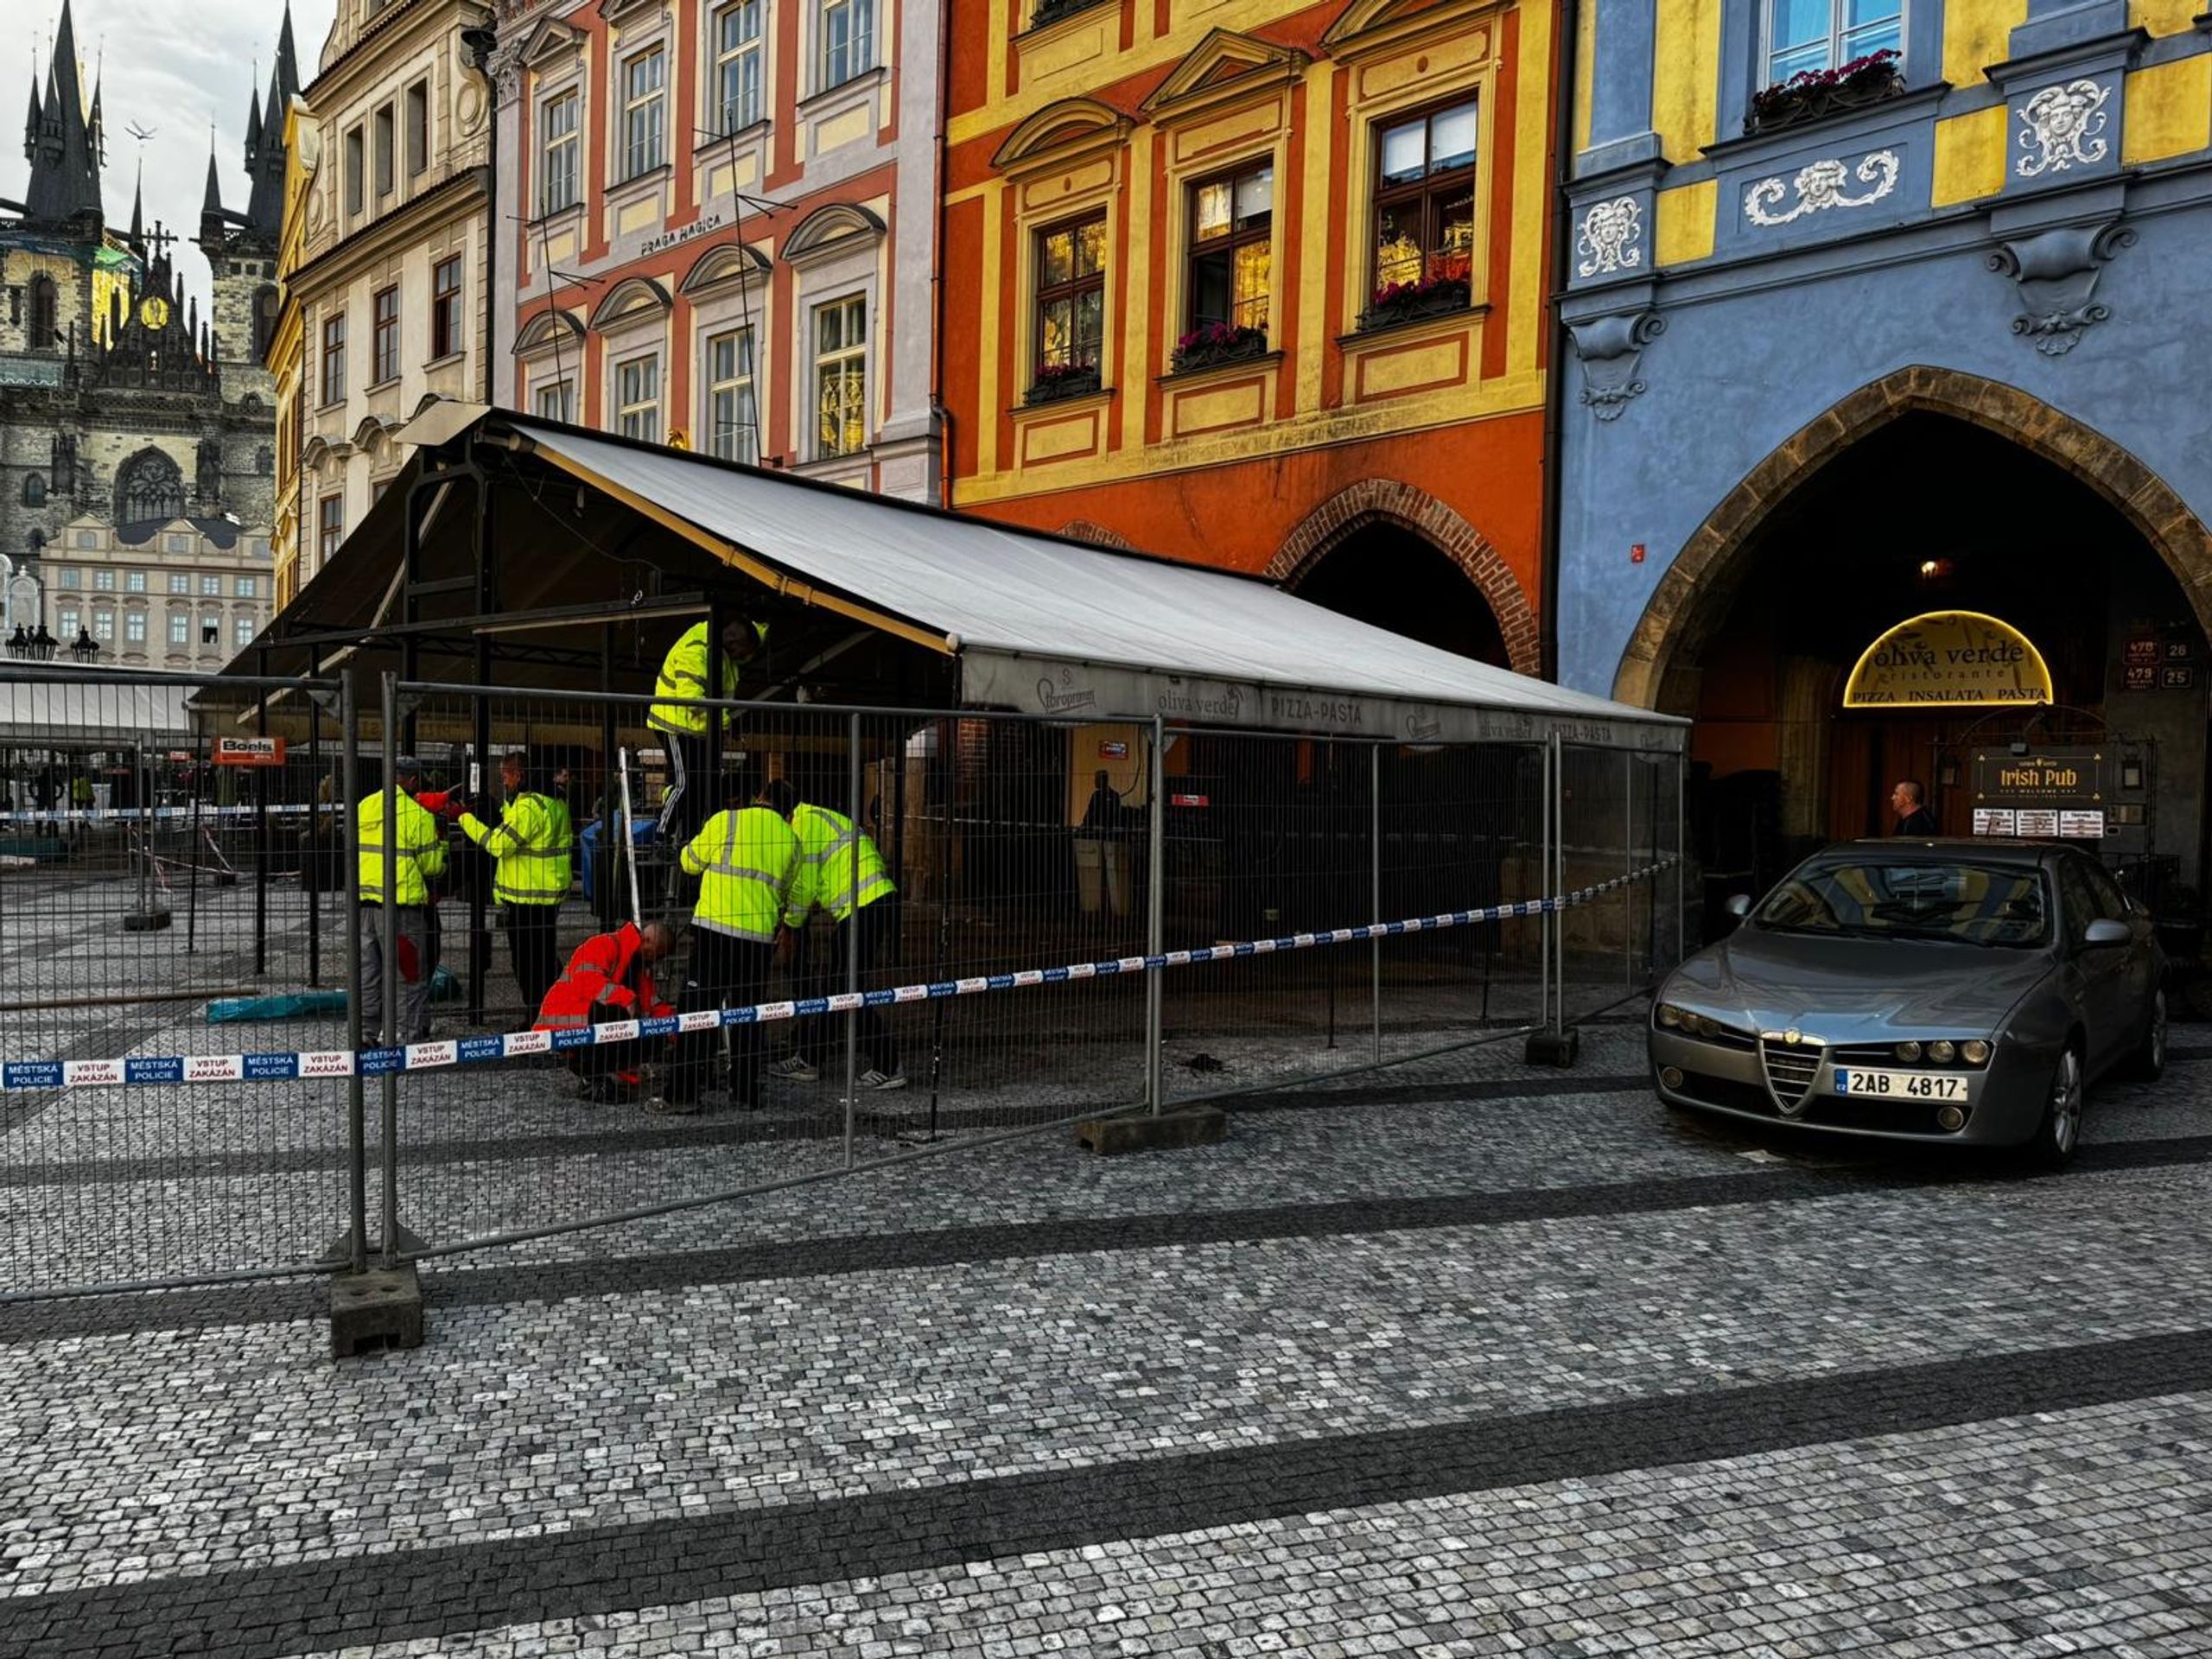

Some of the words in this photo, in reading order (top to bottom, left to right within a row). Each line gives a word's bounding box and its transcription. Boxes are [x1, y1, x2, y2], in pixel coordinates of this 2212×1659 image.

[641, 232, 676, 256] PRAGA
[1874, 643, 1936, 667] oliva
[1947, 639, 2024, 664] verde
[2168, 671, 2186, 683] 25
[1853, 691, 1895, 702] PIZZA
[1909, 690, 1984, 702] INSALATA
[1998, 688, 2047, 700] PASTA
[1158, 690, 1193, 711] oliva
[1197, 695, 1236, 716] verde
[1272, 696, 1363, 725] PIZZA-PASTA
[223, 741, 272, 752] Boels
[2001, 768, 2039, 786] Irish
[2045, 768, 2077, 786] Pub
[464, 1048, 496, 1058] POLICIE
[363, 1059, 397, 1070] POLICIE
[410, 1053, 451, 1065] ZAKÁZÁN
[189, 1068, 235, 1077] ZAKÁZÁN
[251, 1066, 289, 1075] POLICIE
[303, 1064, 347, 1073] ZAKÁZÁN
[13, 1076, 54, 1084] POLICIE
[70, 1072, 118, 1083] ZAKÁZÁN
[135, 1071, 175, 1080] POLICIE
[1853, 1073, 1890, 1093] 2AB
[1906, 1077, 1958, 1097] 4817
